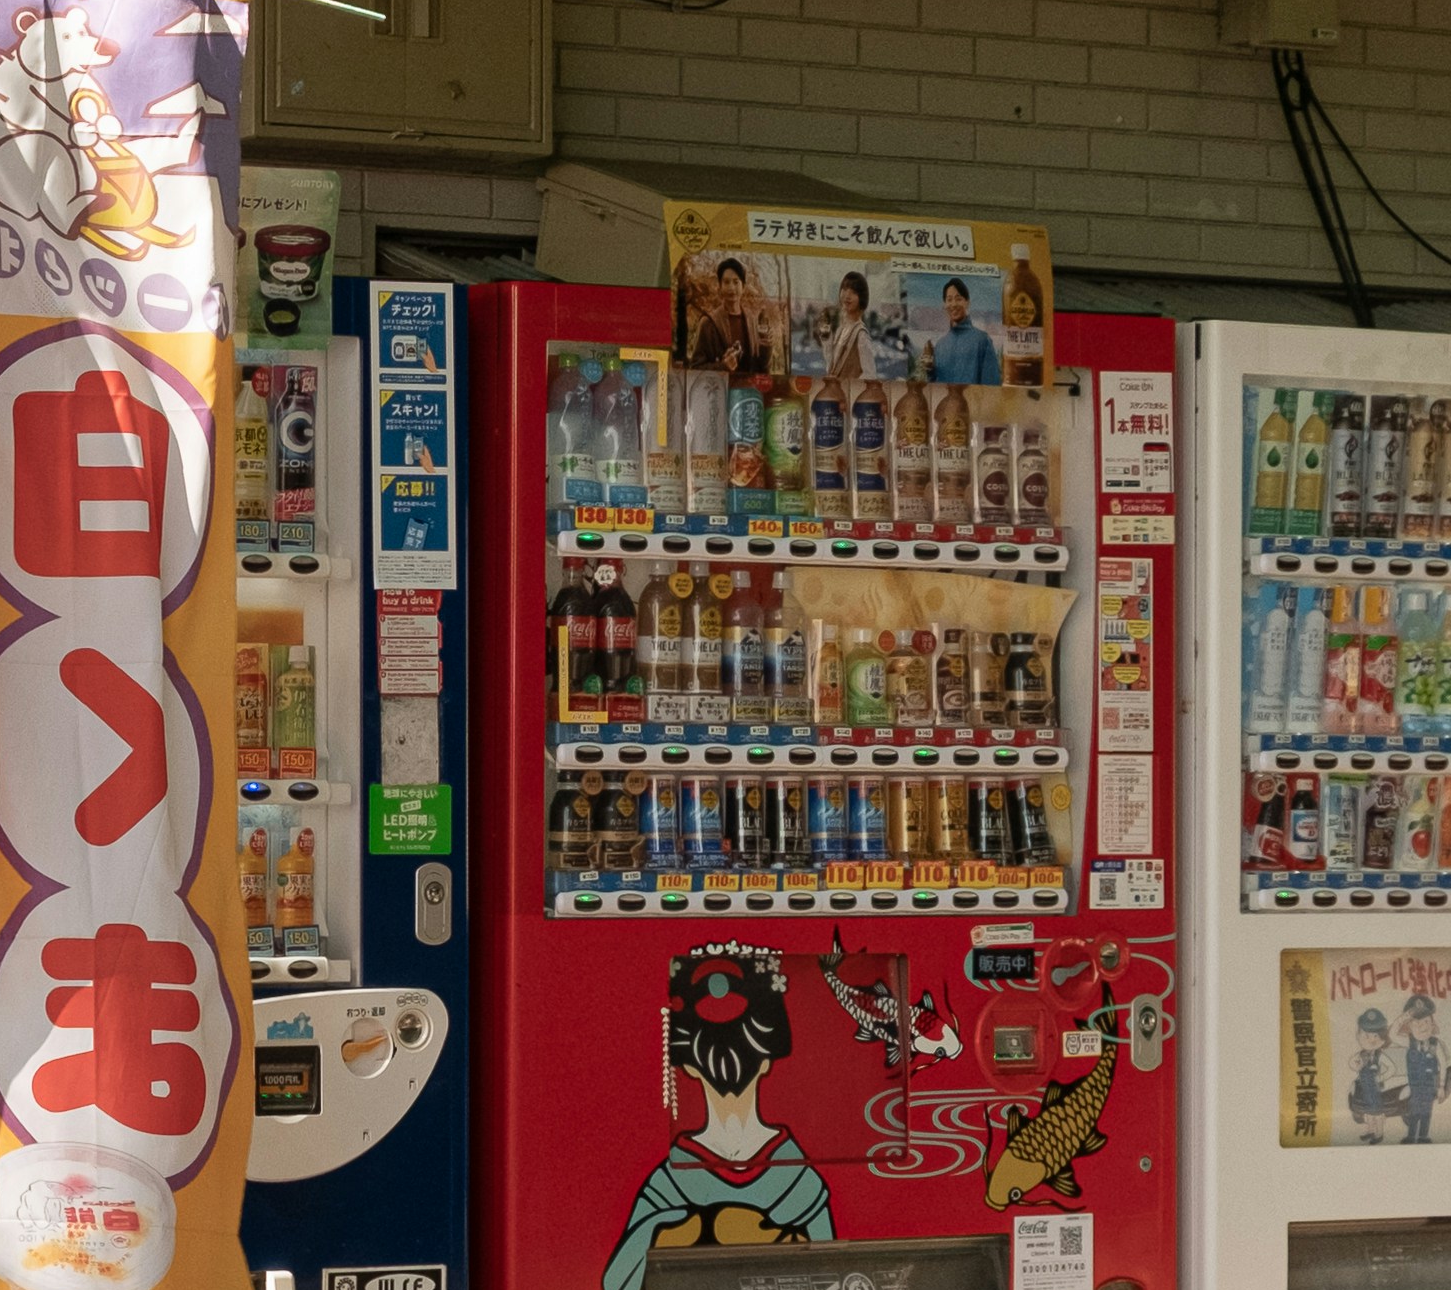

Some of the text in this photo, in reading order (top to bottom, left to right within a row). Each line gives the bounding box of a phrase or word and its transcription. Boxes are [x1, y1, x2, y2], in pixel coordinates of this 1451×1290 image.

[752, 218, 971, 253] ラテ好きにこそ飲んで欲しい。
[391, 303, 436, 318] チェック!
[392, 404, 438, 417] スキャン!
[1104, 396, 1170, 435] 1本無料!
[382, 595, 434, 607] buy a drink
[382, 828, 438, 842] ヒートポンプ
[978, 954, 1028, 975] 販売中
